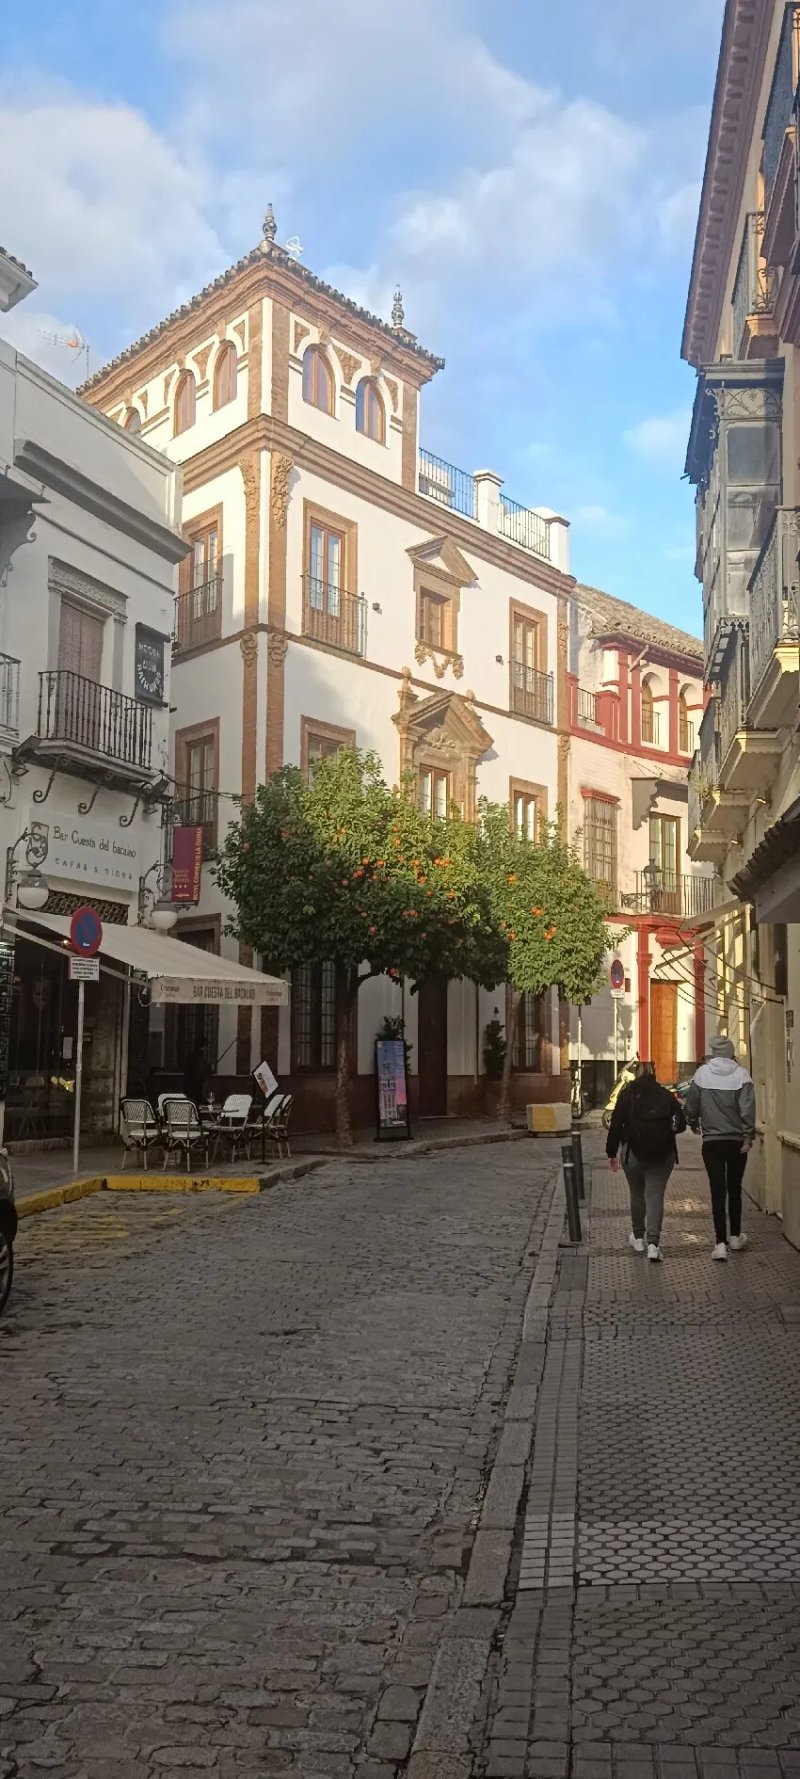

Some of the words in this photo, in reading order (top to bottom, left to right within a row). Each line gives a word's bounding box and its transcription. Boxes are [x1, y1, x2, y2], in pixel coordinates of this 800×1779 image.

[53, 826, 68, 841] Bar
[71, 830, 96, 848] Cuesta
[99, 838, 109, 851] del
[112, 840, 137, 858] bacalao
[193, 985, 203, 998] BAR
[204, 986, 222, 999] CUESTA
[224, 987, 233, 999] DEL
[234, 987, 255, 1000] BACALAO
